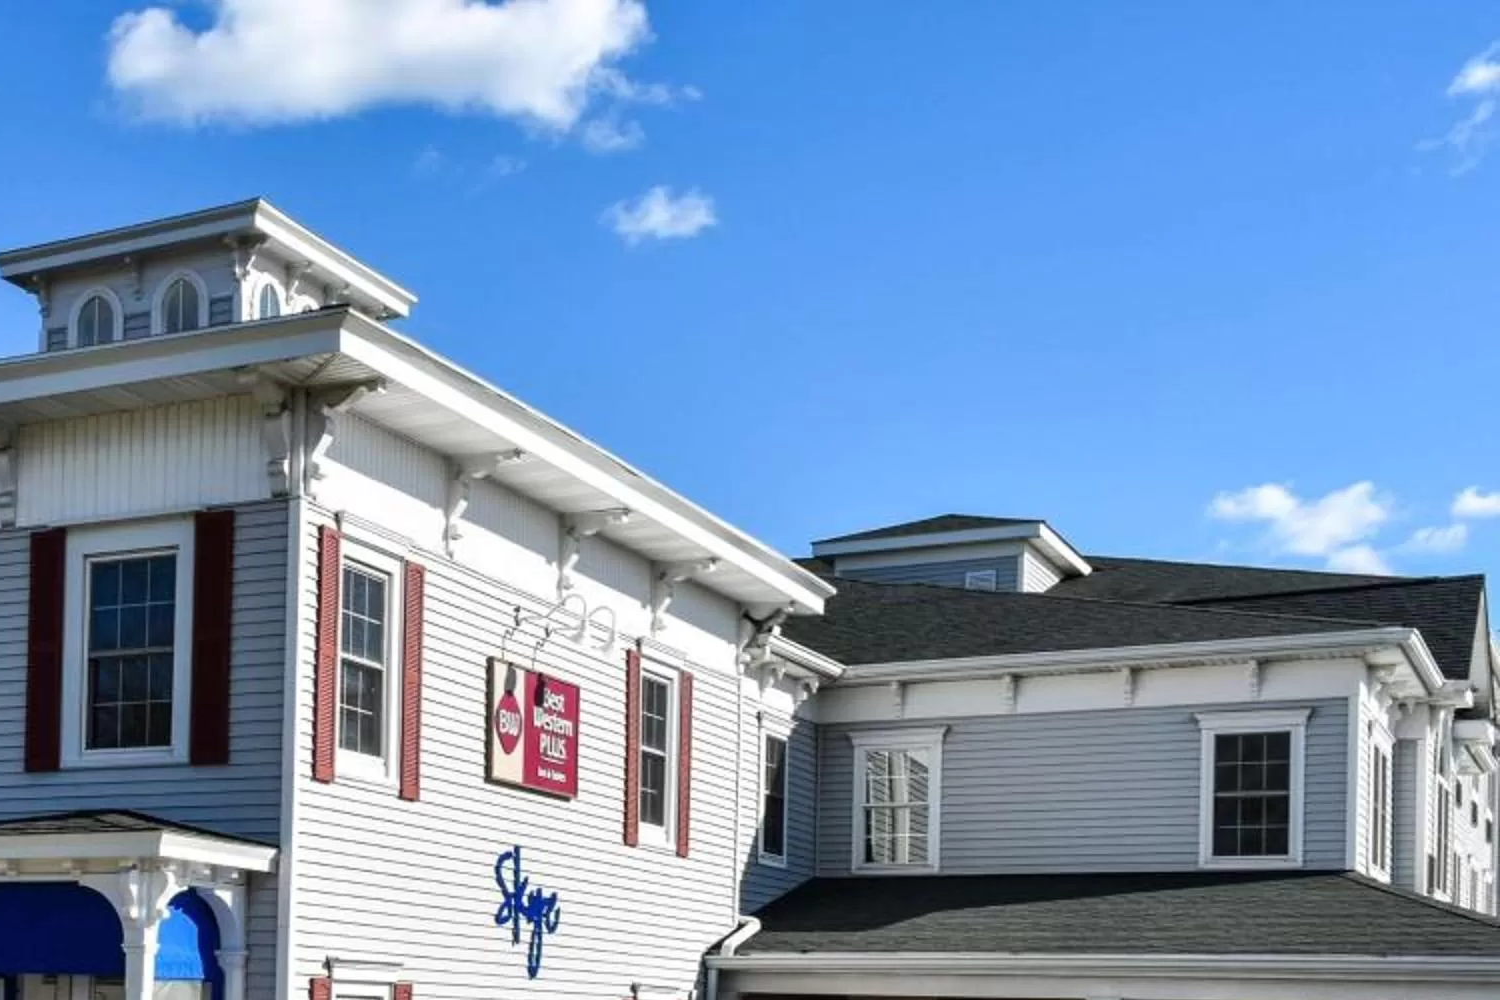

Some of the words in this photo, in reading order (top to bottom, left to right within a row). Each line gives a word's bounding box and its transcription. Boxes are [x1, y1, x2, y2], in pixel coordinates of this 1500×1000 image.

[499, 709, 519, 736] BW
[533, 705, 573, 736] Western
[540, 733, 566, 759] PLUS
